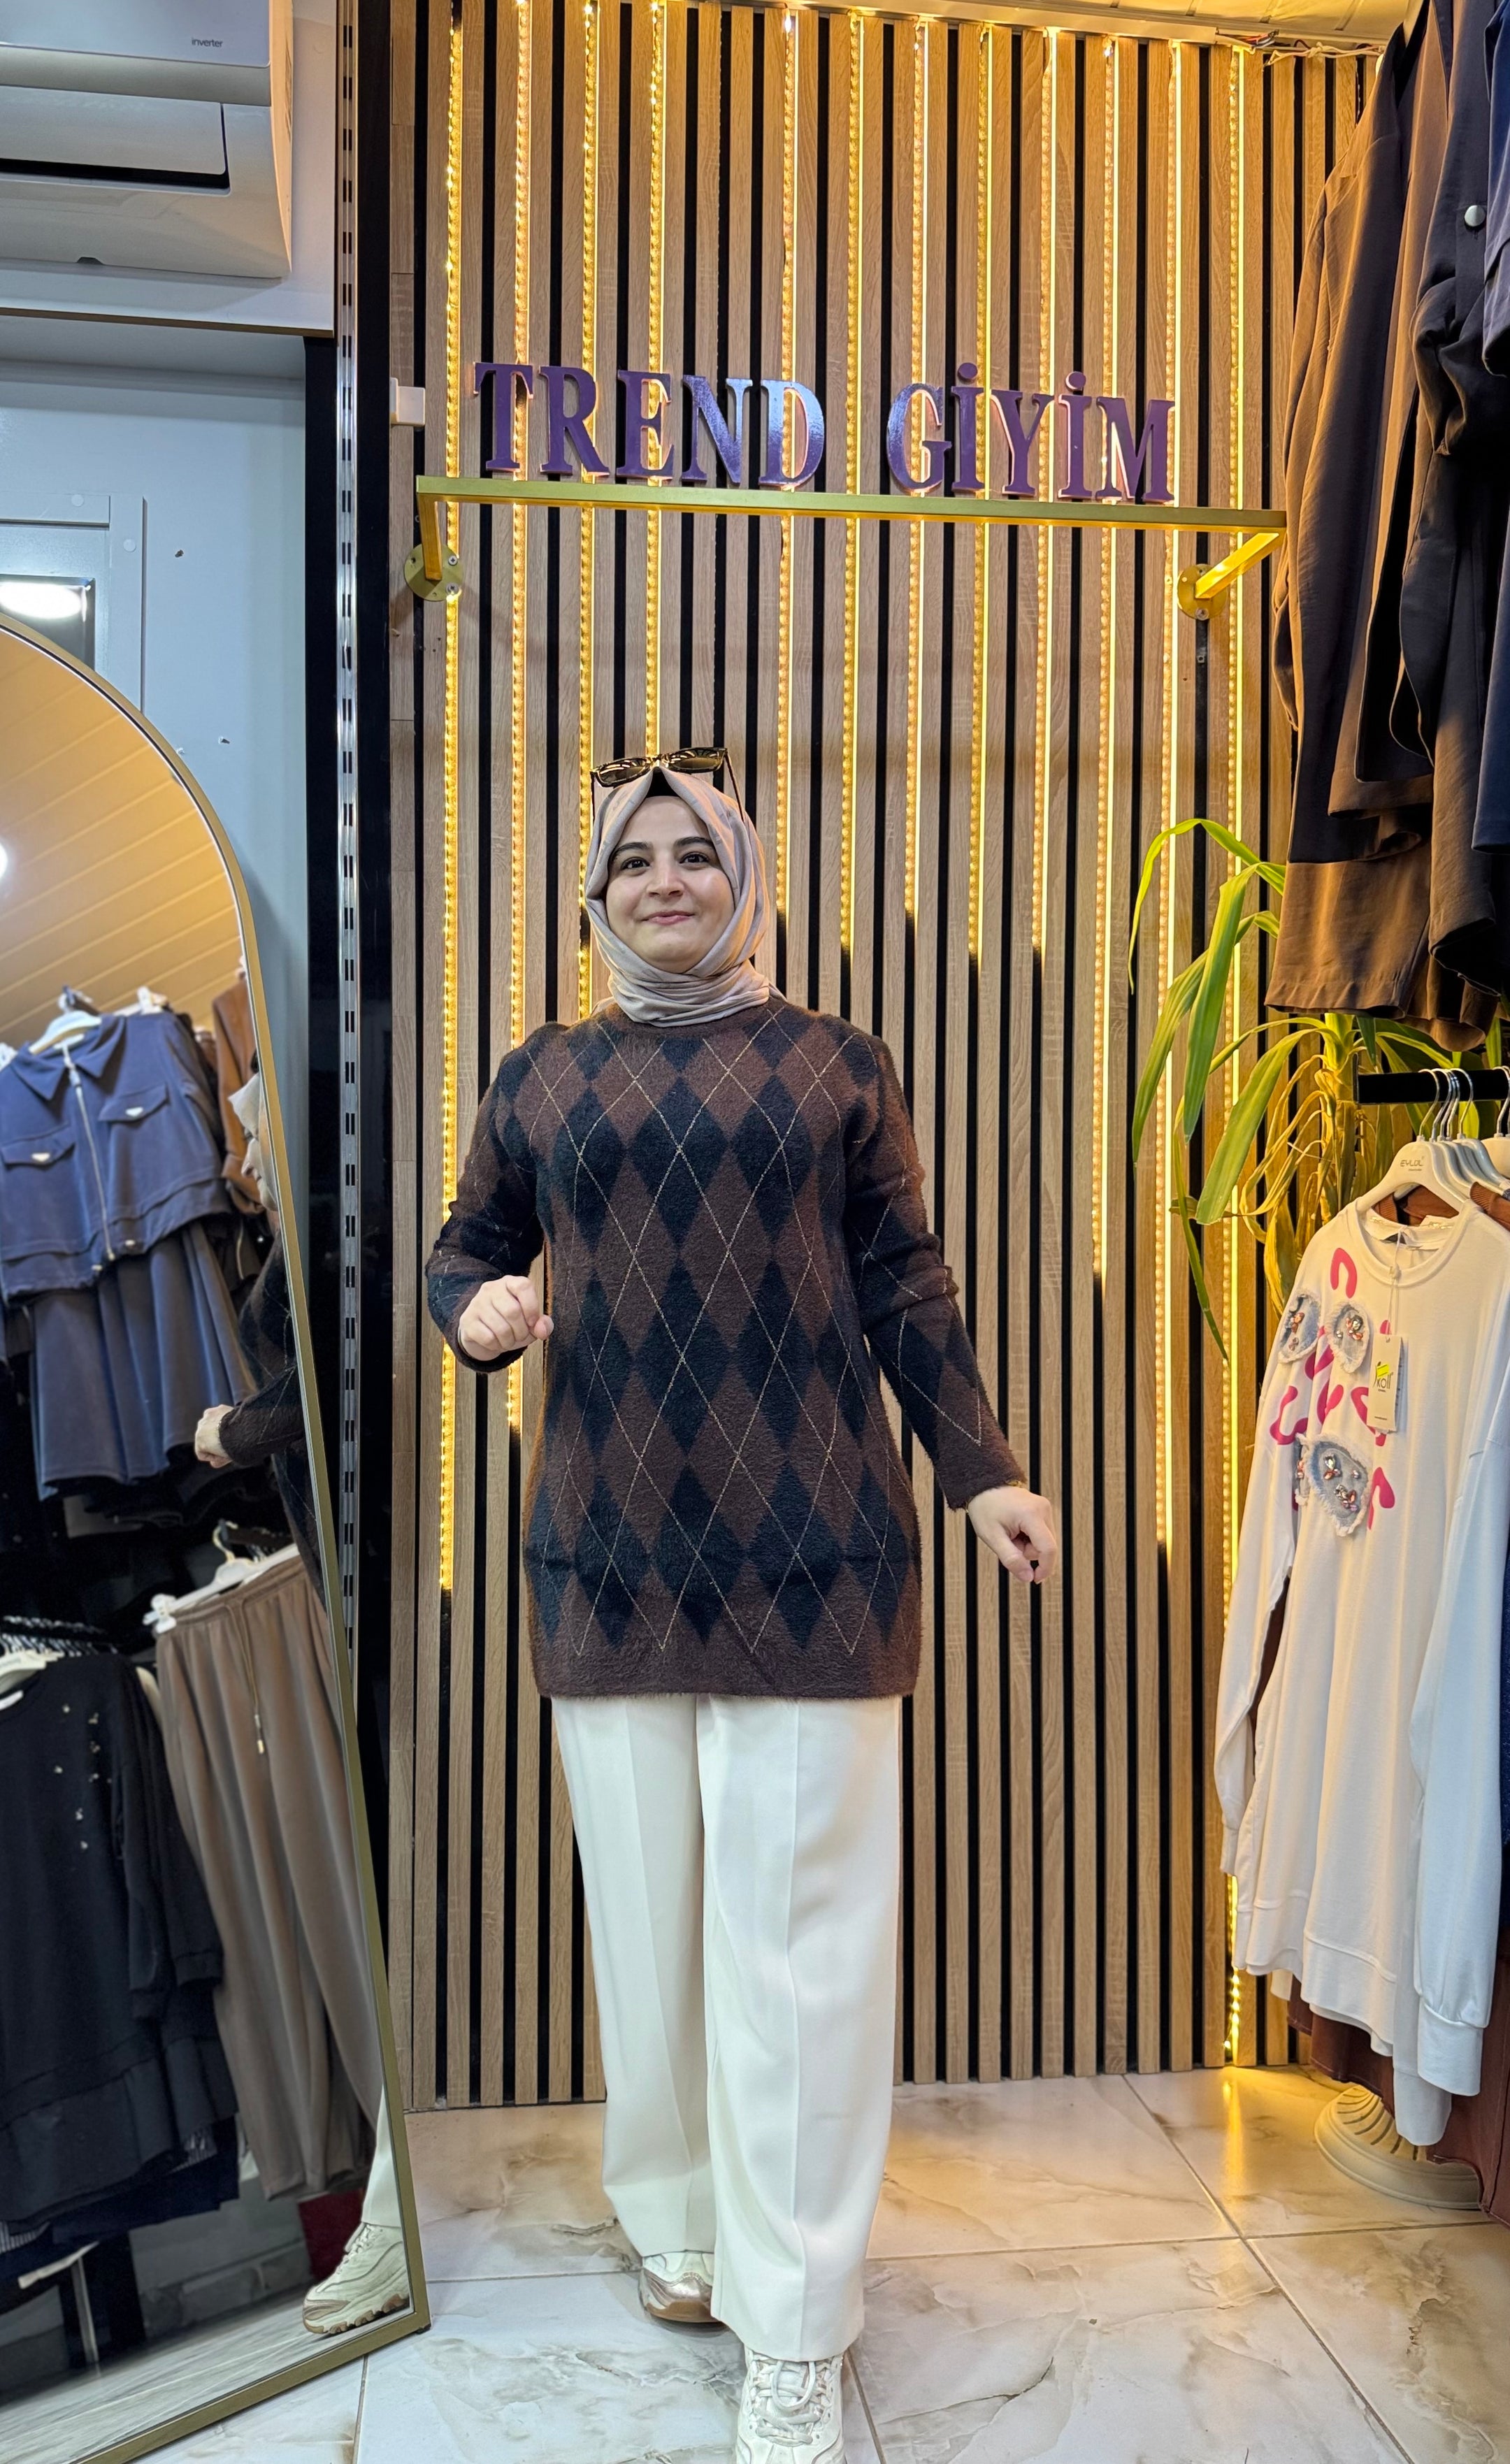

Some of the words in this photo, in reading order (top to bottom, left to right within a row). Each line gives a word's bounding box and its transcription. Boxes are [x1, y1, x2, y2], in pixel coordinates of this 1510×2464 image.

[192, 37, 223, 48] inverter
[473, 361, 825, 487] TREND
[887, 362, 1175, 504] GİYİM
